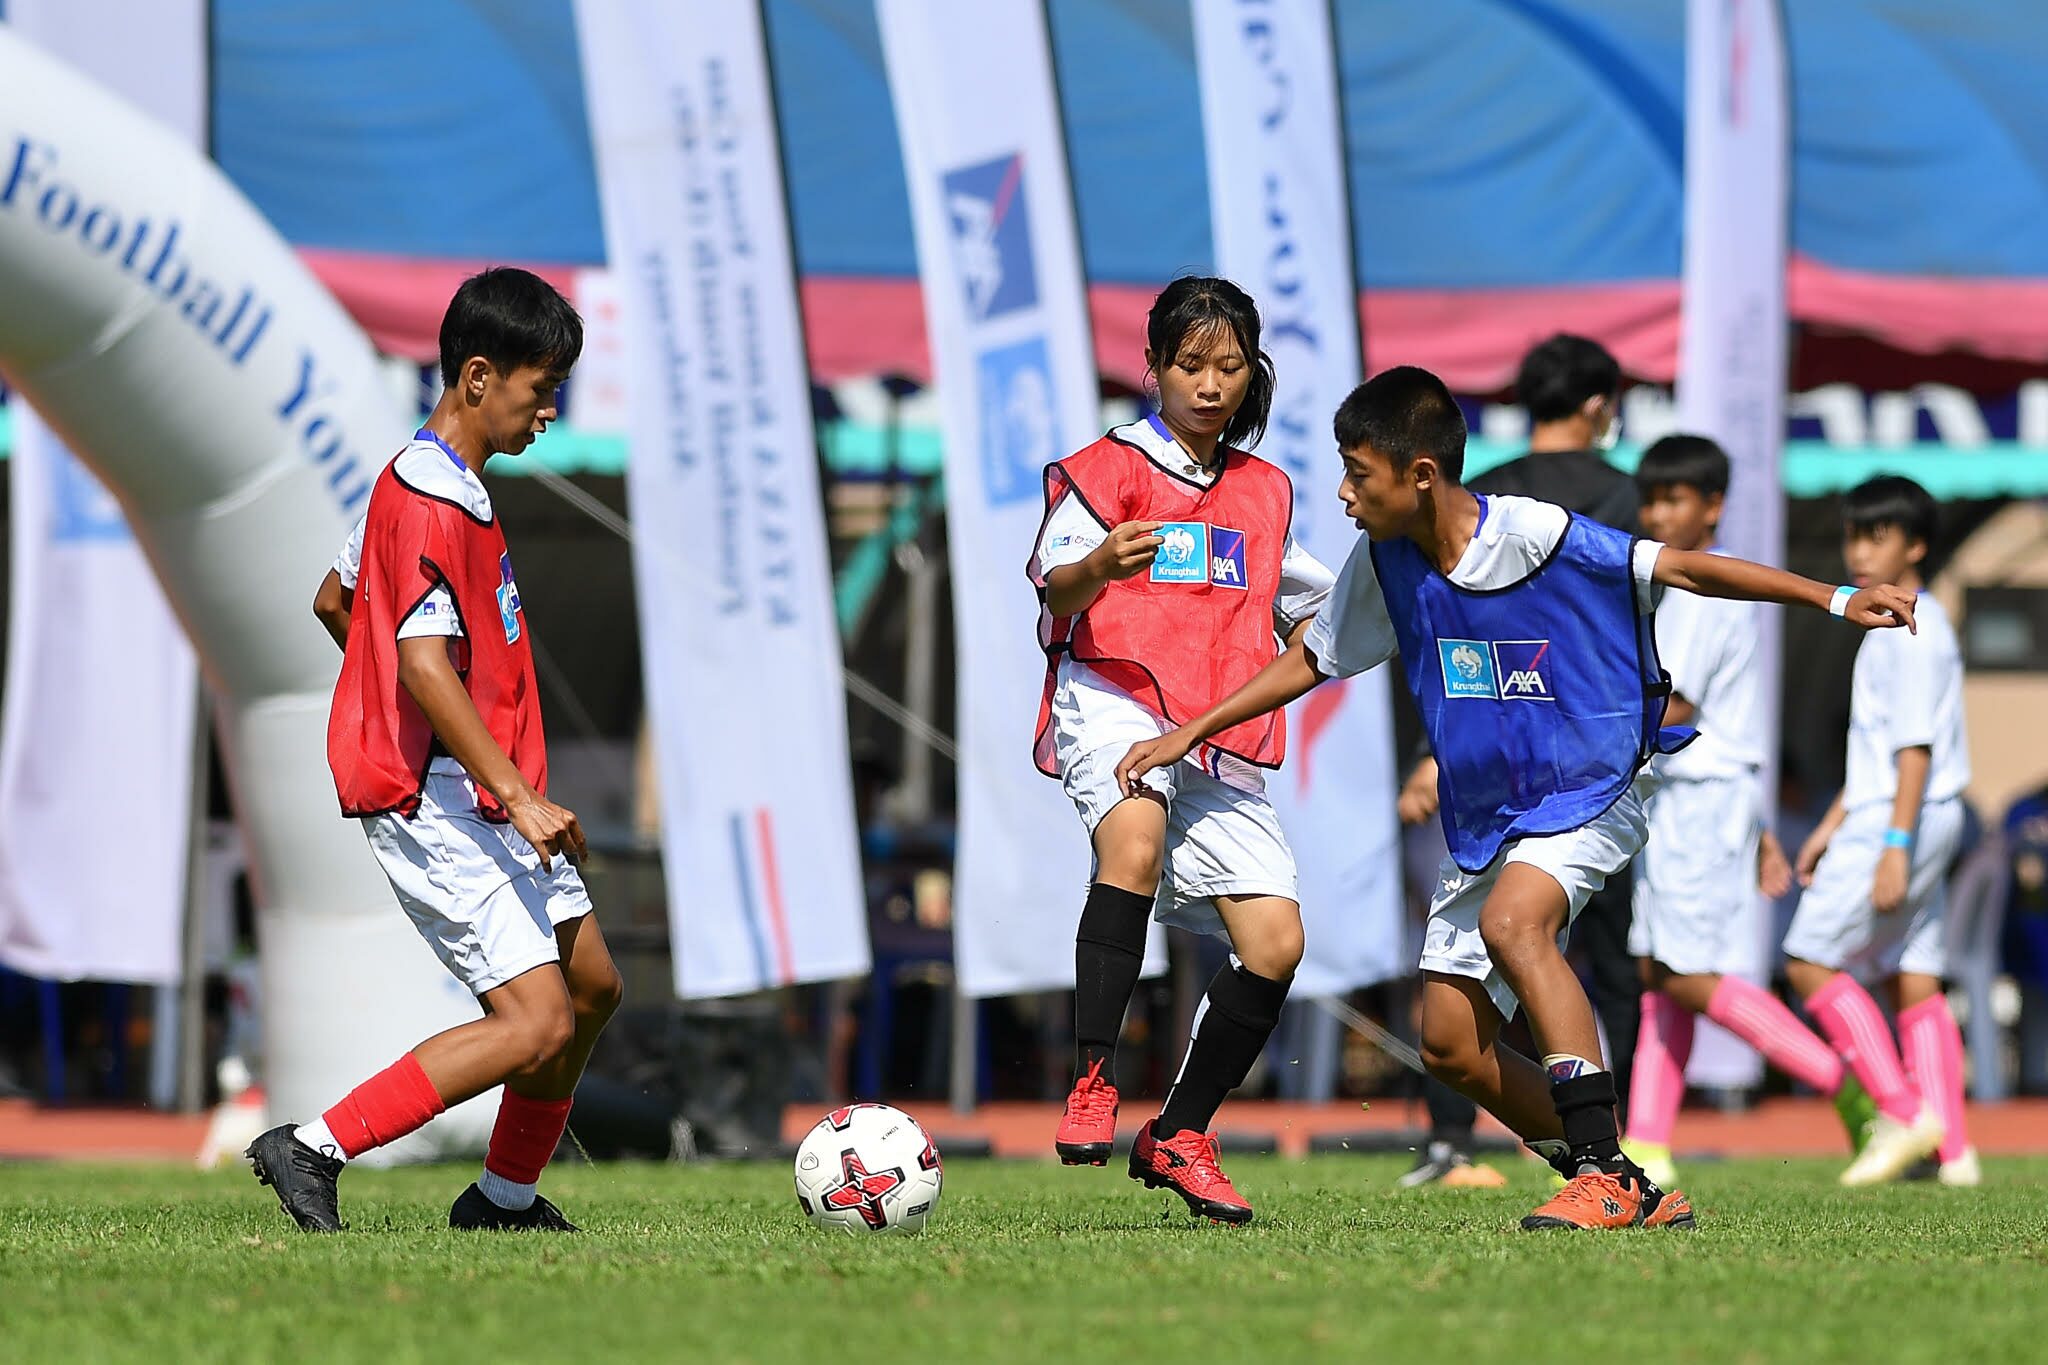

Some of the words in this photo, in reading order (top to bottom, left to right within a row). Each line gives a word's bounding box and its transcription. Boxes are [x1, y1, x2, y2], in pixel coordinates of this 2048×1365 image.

[0, 135, 275, 366] Football
[1157, 565, 1200, 579] Krungthai
[1211, 555, 1241, 584] AXA
[1452, 681, 1492, 693] Krungthai
[1502, 669, 1547, 694] AXA
